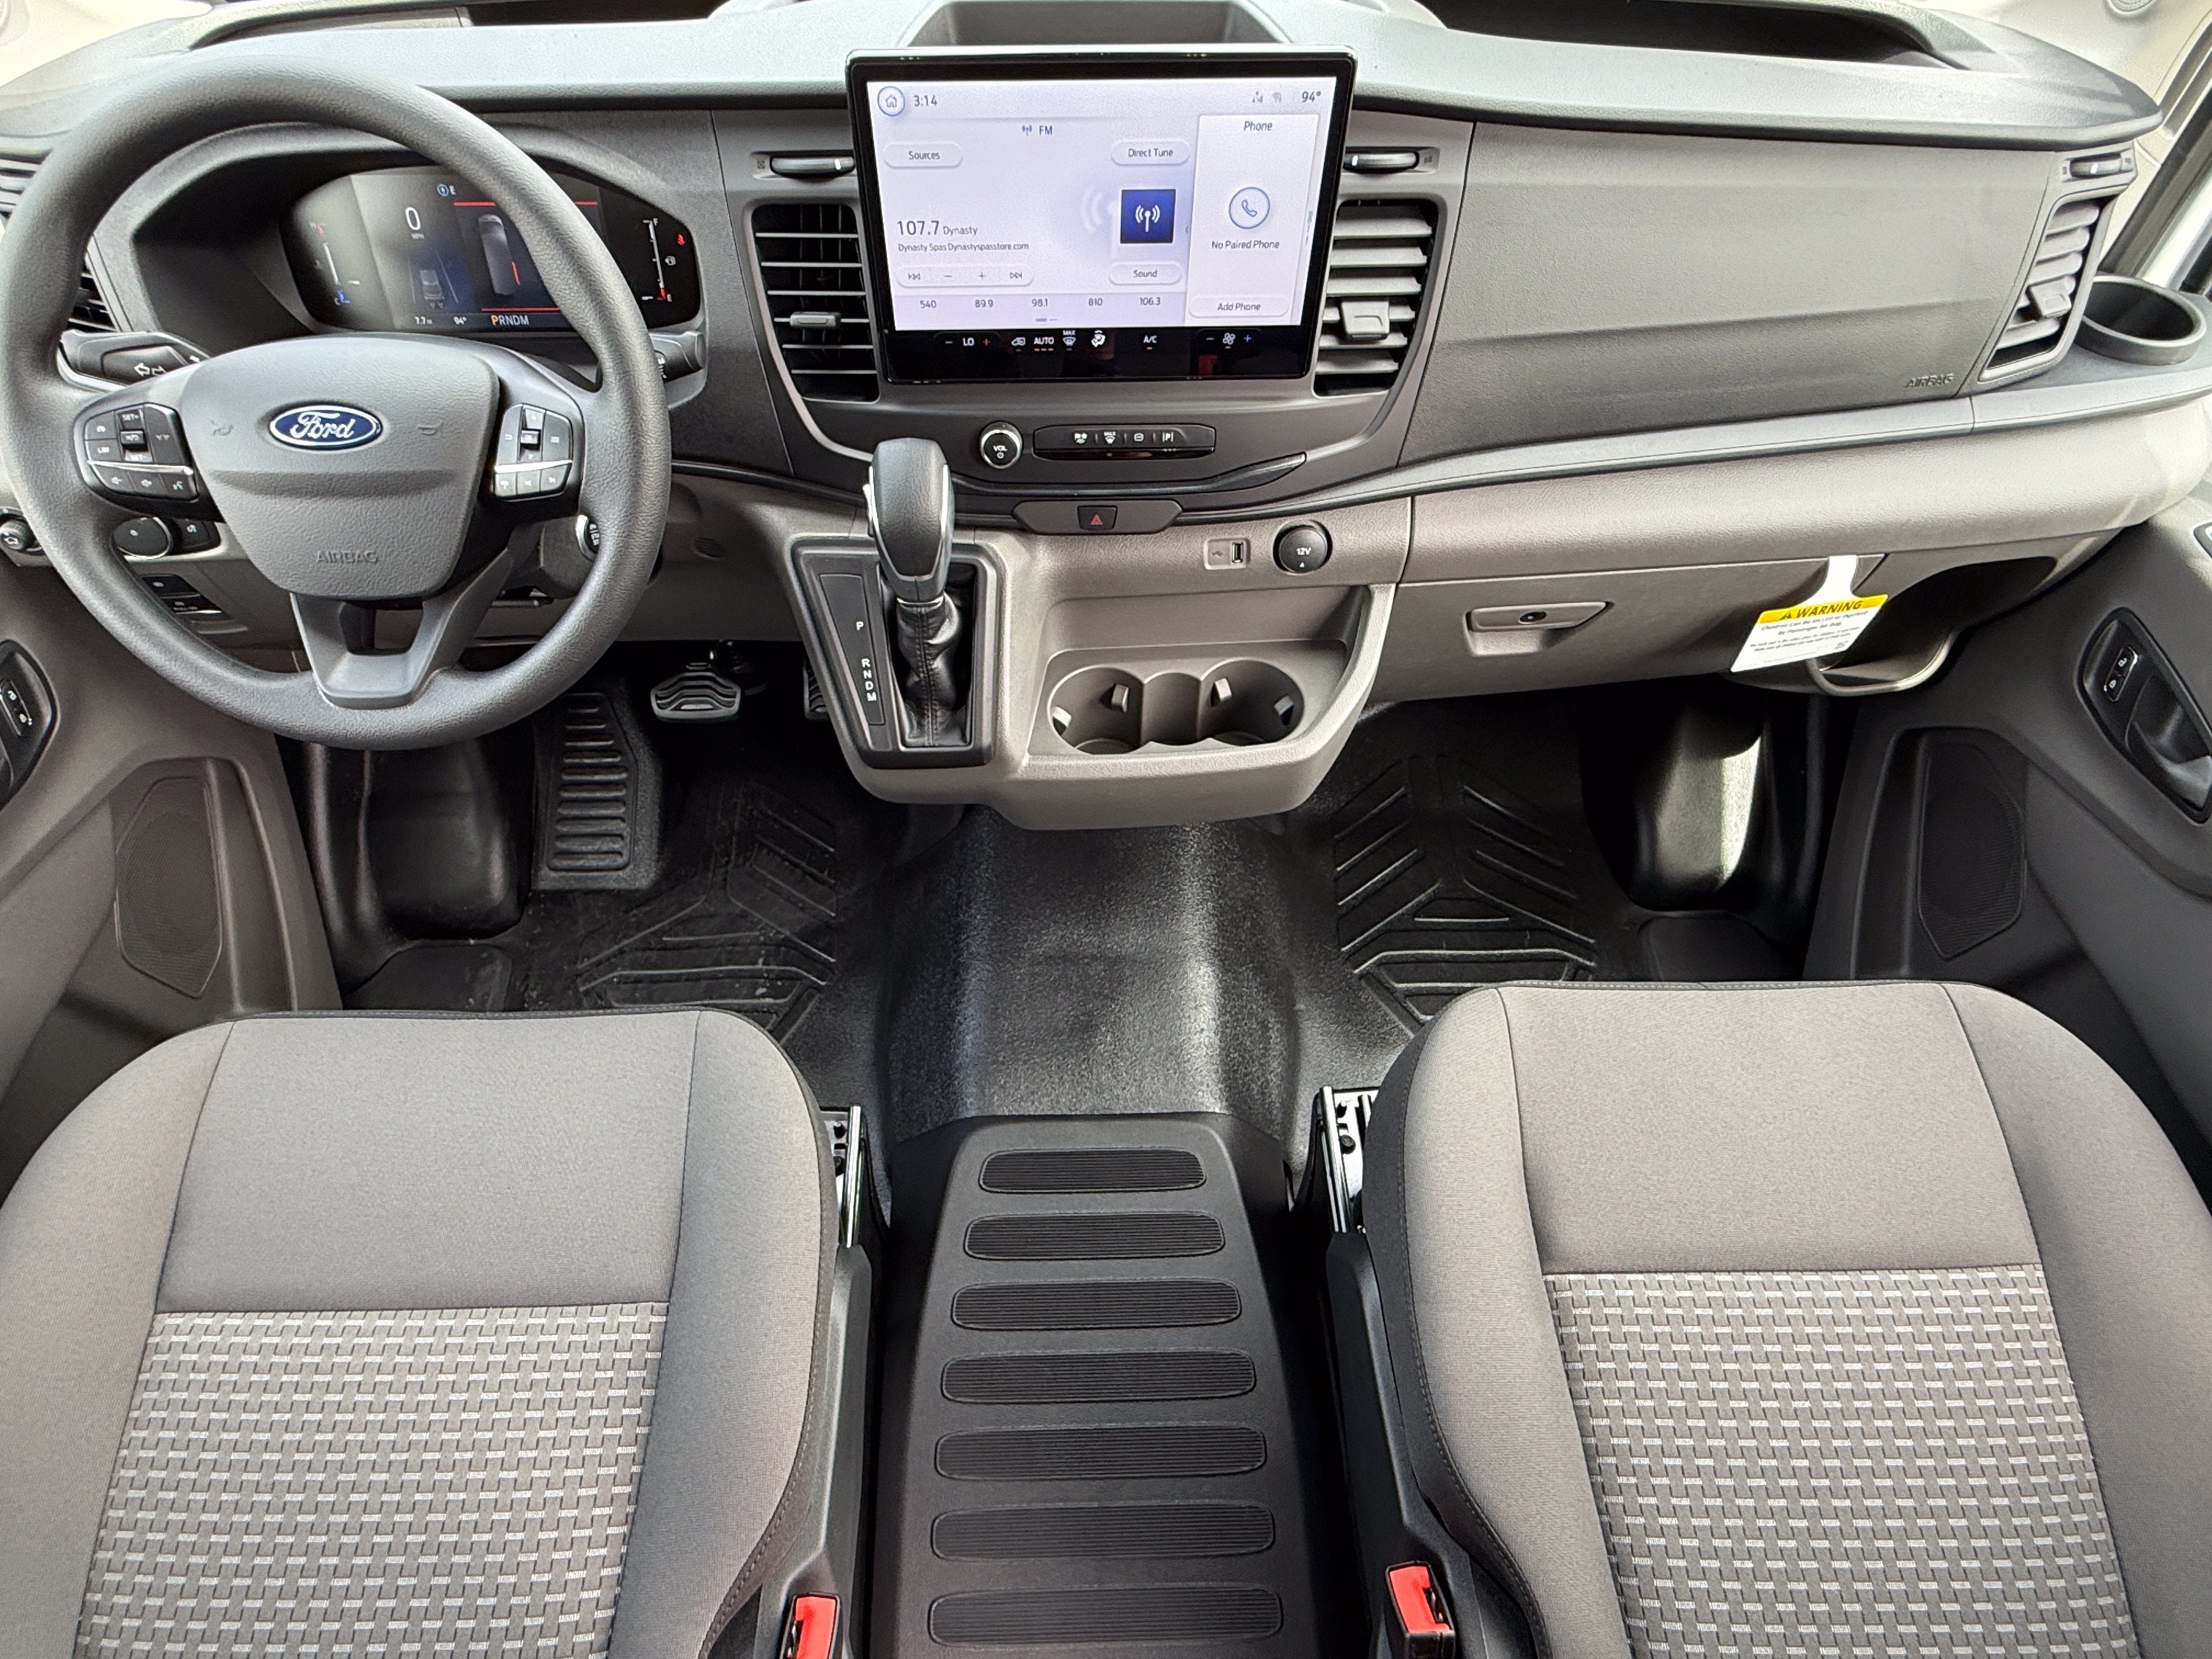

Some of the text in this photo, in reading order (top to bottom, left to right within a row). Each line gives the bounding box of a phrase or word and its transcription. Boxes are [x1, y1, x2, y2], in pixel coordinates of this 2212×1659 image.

[913, 94, 938, 107] 3:14
[1039, 125, 1053, 136] FM
[1243, 121, 1273, 132] Phone
[909, 150, 940, 160] Sources
[1128, 148, 1173, 157] Direct Tune
[896, 220, 978, 236] 107.7 Dynasty
[898, 244, 927, 253] Dynasty
[929, 243, 946, 252] Spas
[1211, 240, 1280, 249] No Paired Phone
[1133, 269, 1158, 278] Sound
[919, 300, 936, 308] 540
[974, 299, 994, 308] 89.9
[1031, 298, 1048, 307] 98.1
[1088, 298, 1103, 306] 810
[1139, 297, 1161, 306] 106.3
[1217, 302, 1261, 311] Add Phone
[491, 314, 530, 326] PRNDM
[962, 337, 975, 347] LO
[1034, 336, 1054, 345] AUTO
[1143, 335, 1158, 344] A/C
[290, 411, 356, 439] Ford
[1296, 546, 1312, 555] 12V
[316, 549, 379, 564] AIRBAG
[1796, 600, 1864, 619] WARNING
[856, 621, 864, 631] P
[861, 658, 871, 668] R
[863, 670, 872, 679] N
[865, 681, 874, 691] D
[867, 692, 877, 702] M
